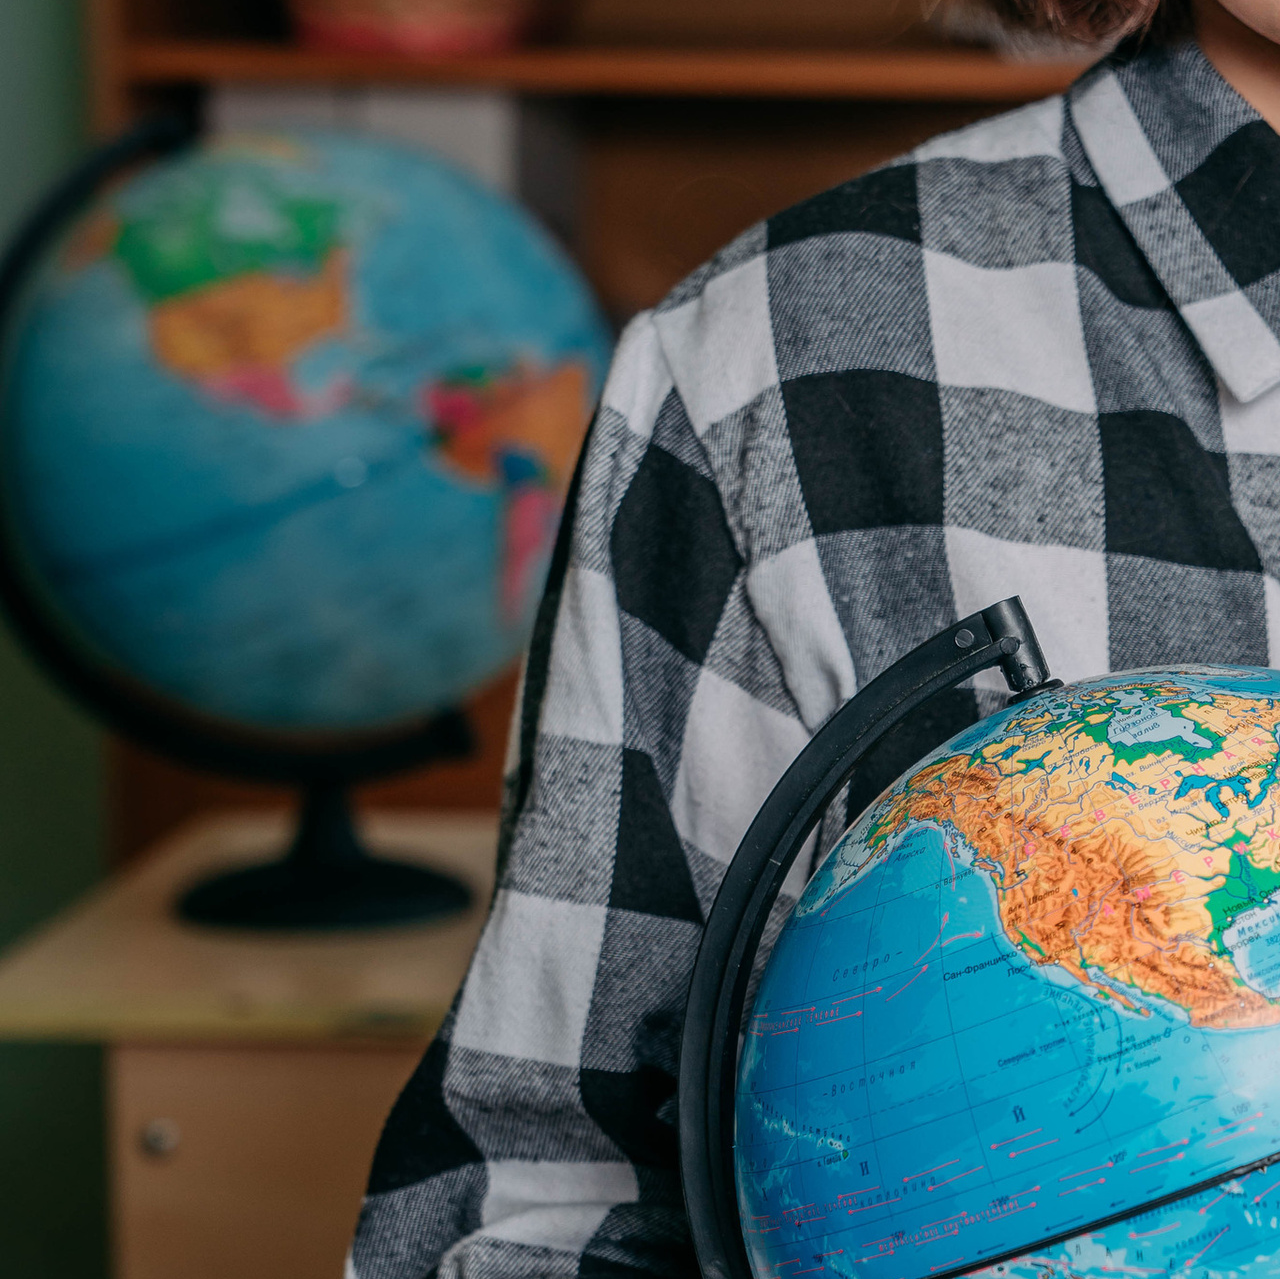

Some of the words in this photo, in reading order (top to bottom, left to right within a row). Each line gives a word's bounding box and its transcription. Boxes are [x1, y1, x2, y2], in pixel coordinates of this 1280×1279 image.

[1113, 711, 1158, 734] Гудзонов
[1133, 722, 1160, 739] залив
[1024, 737, 1265, 856] СЕВЕРНАЯ
[1185, 818, 1220, 837] Чикаго
[1222, 897, 1257, 915] Новый
[942, 951, 1018, 982] Сан-Франциско
